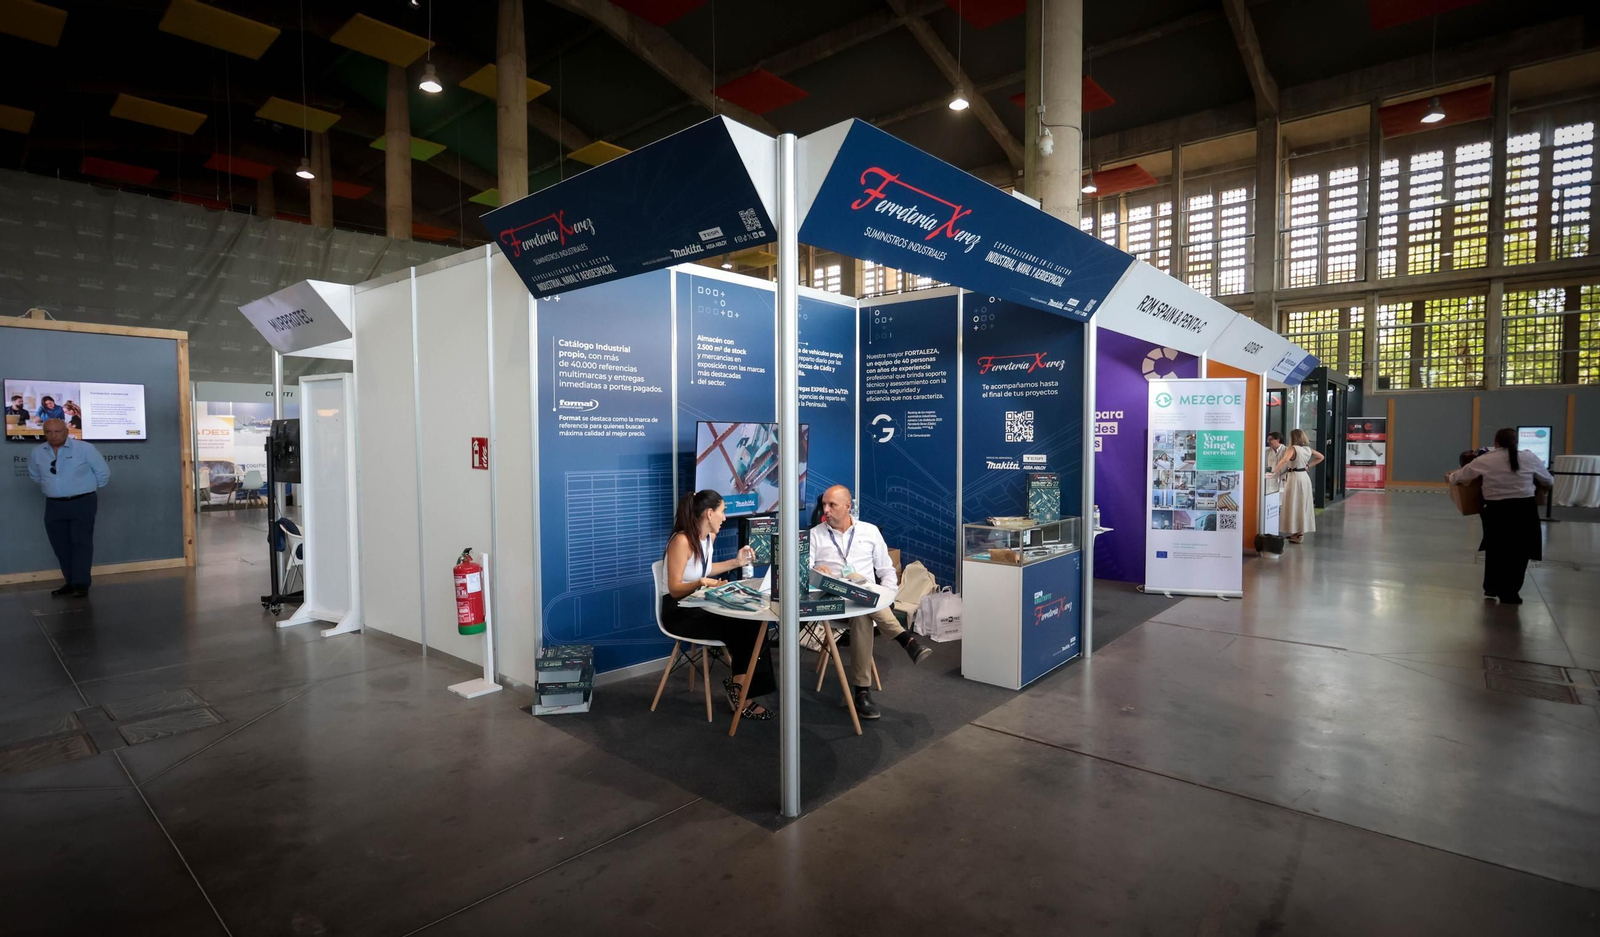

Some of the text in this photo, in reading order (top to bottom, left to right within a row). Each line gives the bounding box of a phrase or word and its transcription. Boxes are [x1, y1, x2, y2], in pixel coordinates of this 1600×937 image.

[851, 167, 981, 253] Ferretería Xerez
[500, 210, 595, 257] Ferretería Xerez
[864, 227, 947, 261] SUMINISTROS INDUSTRIALES
[533, 244, 588, 265] SUMINISTROS INDUSTRIALES
[994, 241, 1039, 263] ESPECIALIZADOS
[1054, 265, 1072, 275] SECTOR
[985, 251, 1017, 271] INDUSTRIAL,
[1015, 261, 1033, 276] NAVAL
[1033, 269, 1066, 287] AEROESPACIAL
[267, 309, 313, 332] MURPROTEC
[1136, 295, 1207, 333] R2M SPAIN & PENTA-C
[697, 335, 722, 343] Almacén
[559, 340, 630, 353] Catálogo Industrial
[559, 351, 586, 359] propio,
[571, 361, 597, 369] 40.000
[599, 363, 637, 372] referencias
[977, 352, 1065, 374] Ferretería Xerez
[559, 371, 606, 380] multimarcas
[614, 375, 644, 383] entregas
[711, 371, 741, 379] destacadas
[559, 380, 601, 389] inmediatas
[1095, 424, 1115, 433] des
[1203, 433, 1229, 441] Your
[1204, 441, 1235, 451] Single
